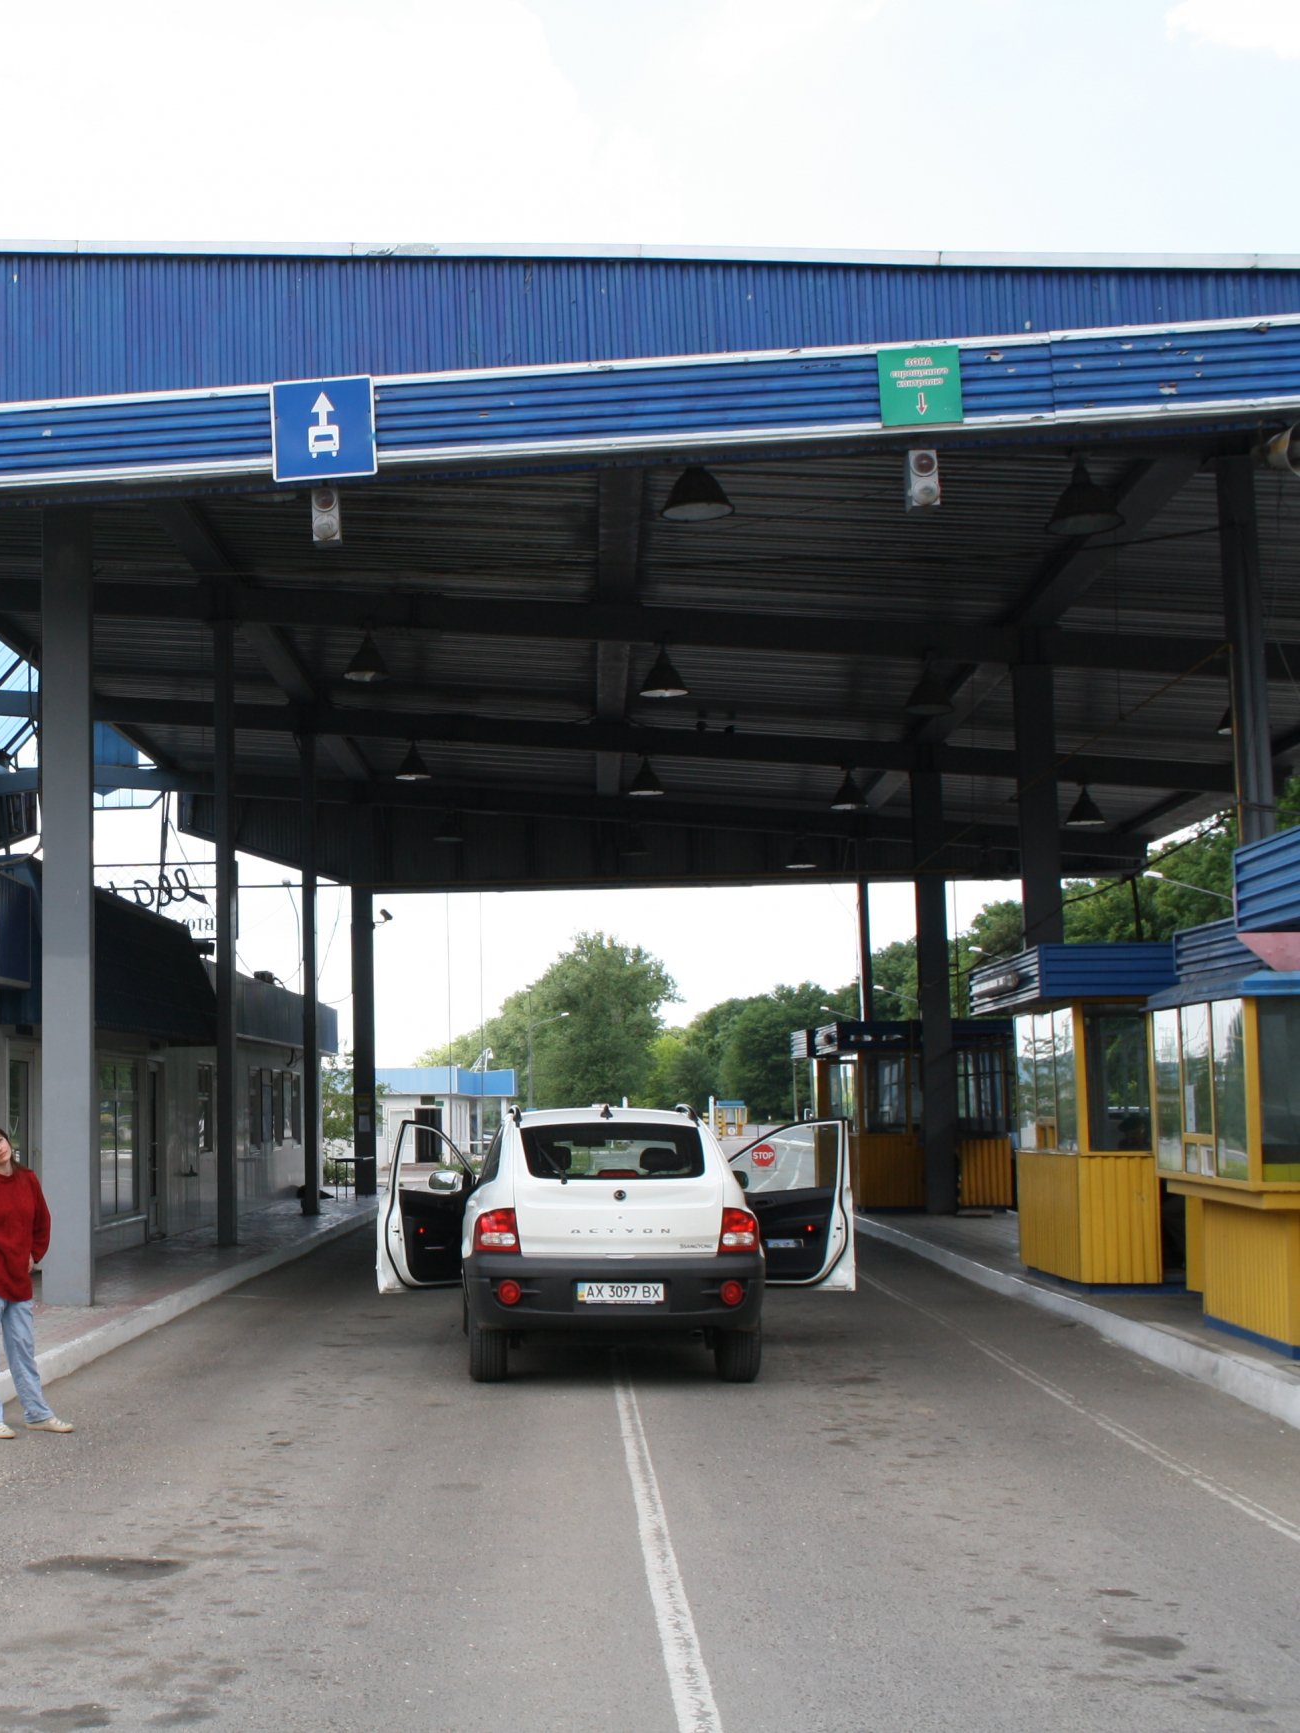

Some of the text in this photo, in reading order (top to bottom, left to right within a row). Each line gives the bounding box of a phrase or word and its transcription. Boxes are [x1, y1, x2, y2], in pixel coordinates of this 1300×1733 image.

[752, 1151, 774, 1160] STOP
[586, 1285, 660, 1298] AX 3097 BX
